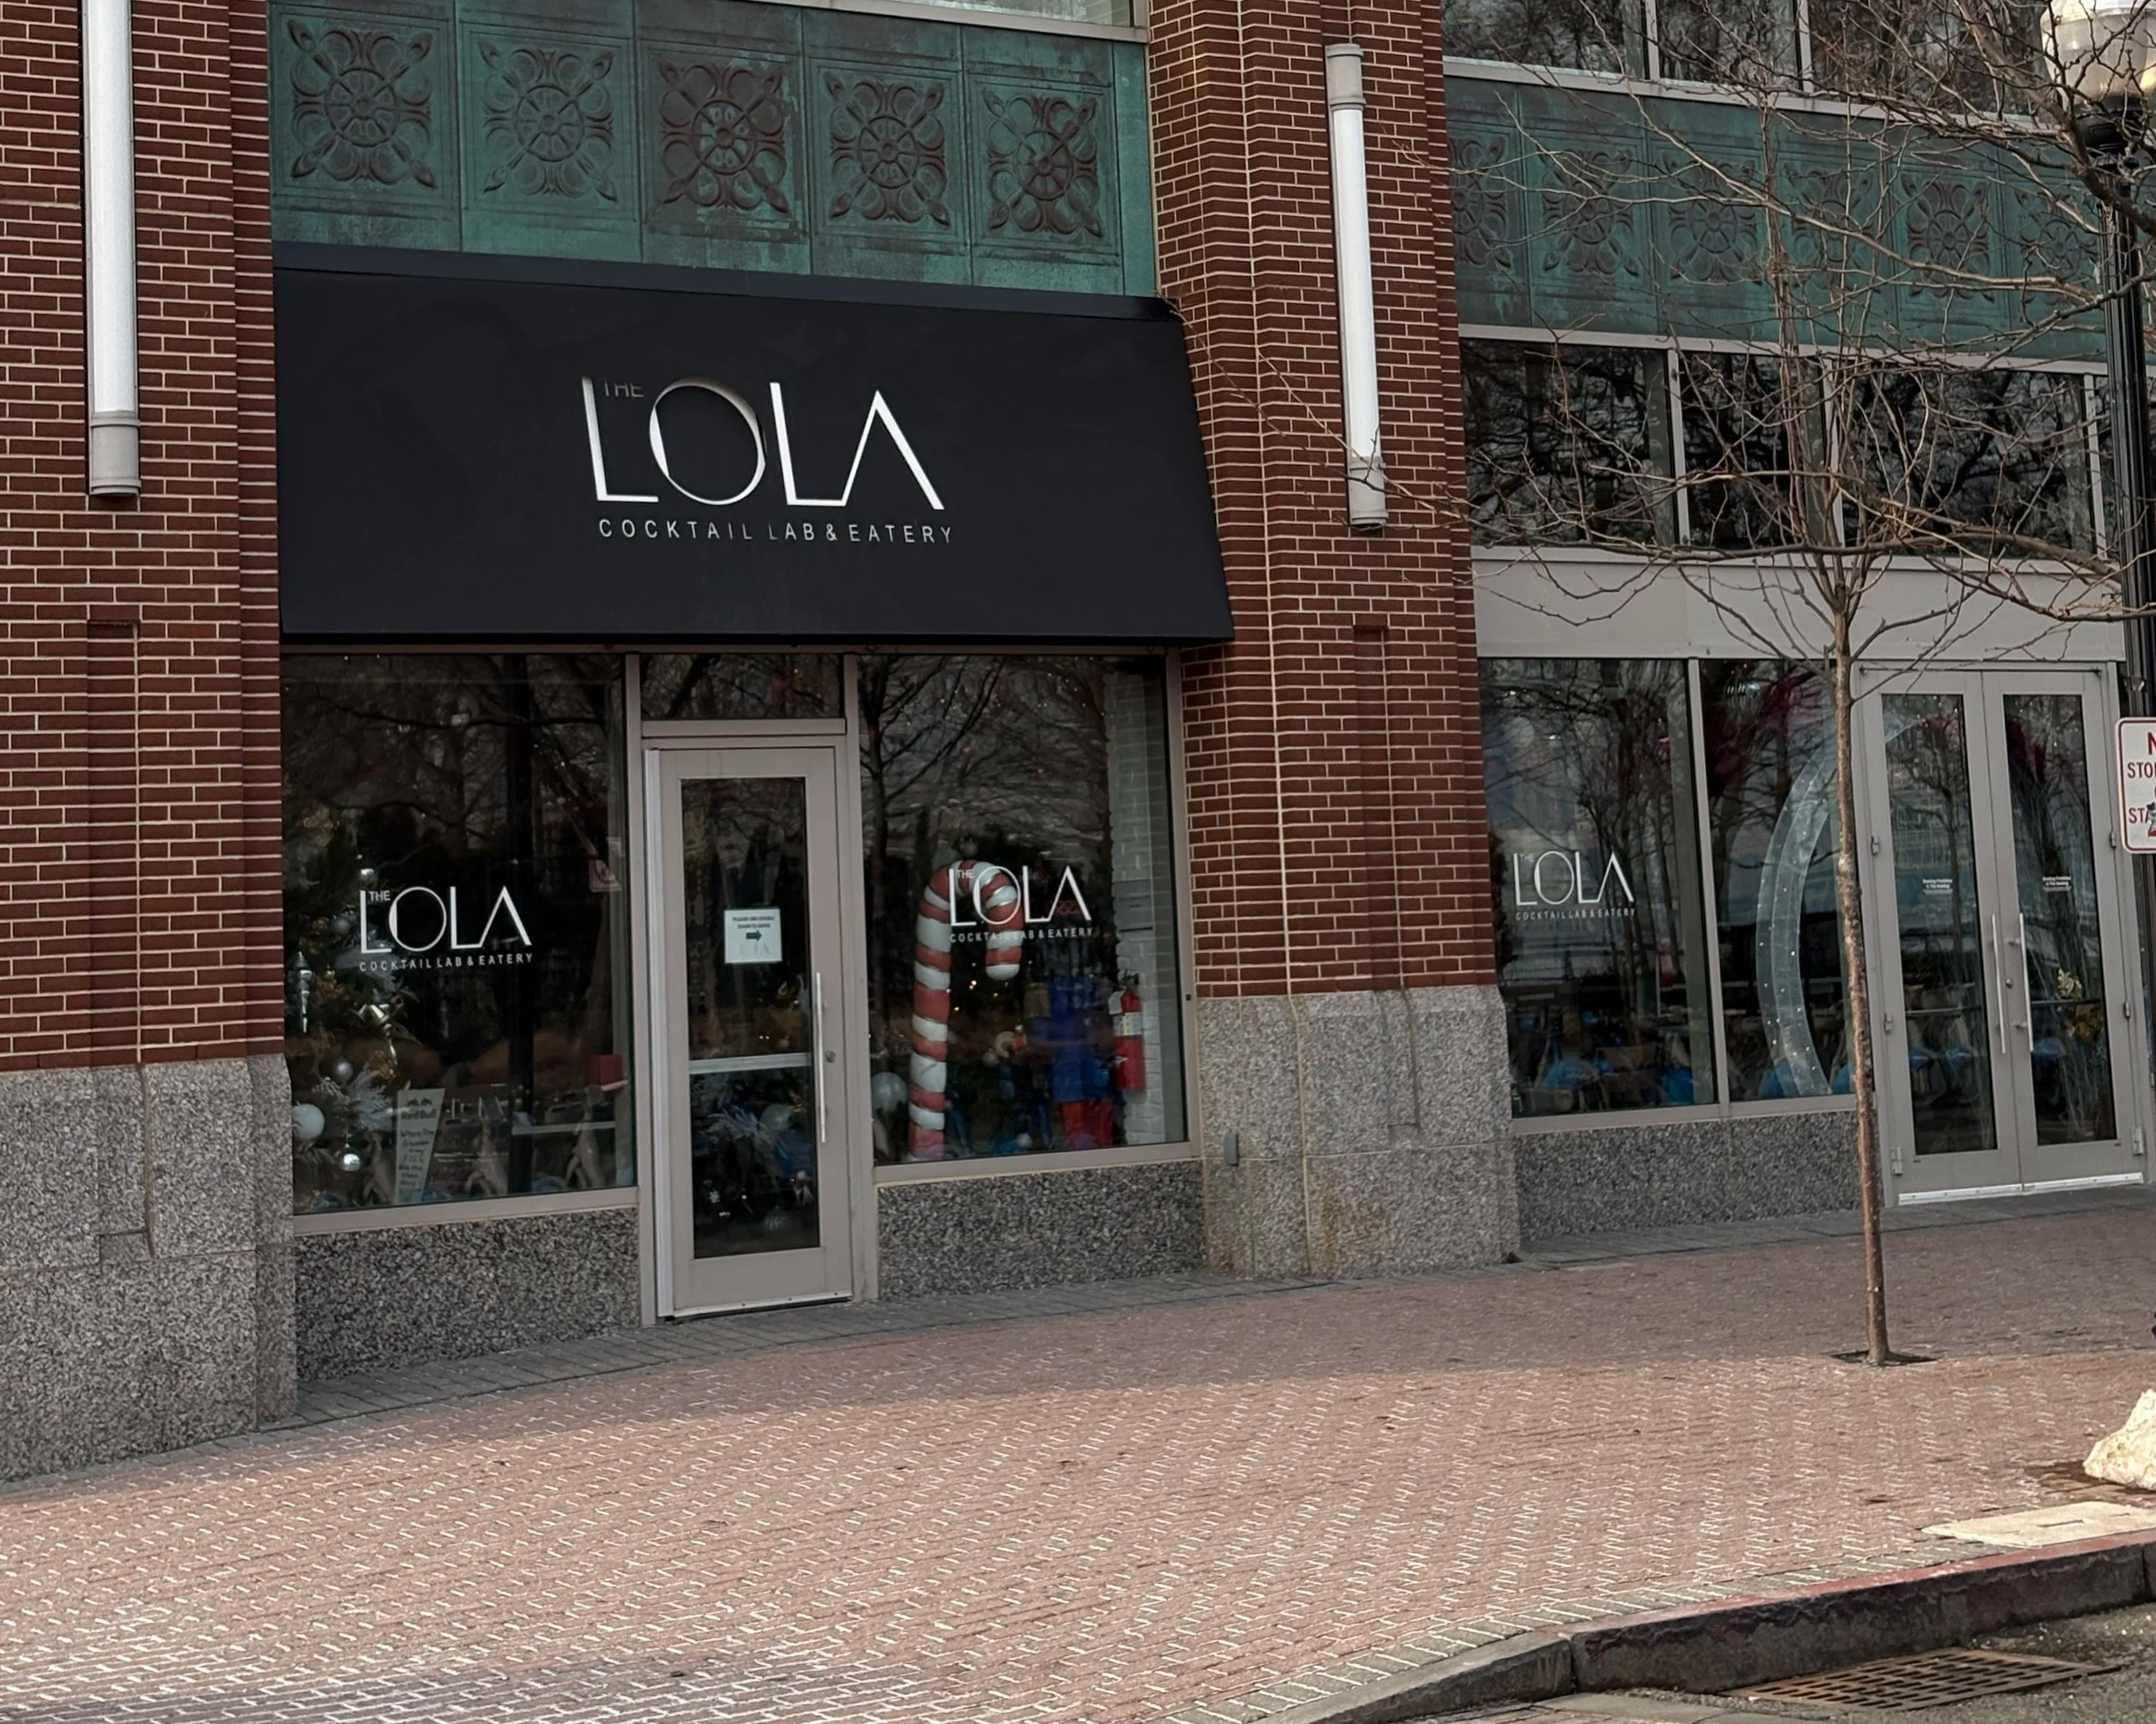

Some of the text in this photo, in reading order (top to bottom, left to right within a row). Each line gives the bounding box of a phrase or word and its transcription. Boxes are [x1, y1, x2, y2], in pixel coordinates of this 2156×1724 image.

[604, 380, 644, 397] THE
[582, 377, 944, 510] LOLA
[598, 519, 952, 543] COCKTAIL LAB & EATERY
[2127, 761, 2156, 779] STO
[956, 868, 974, 879] THE
[1513, 851, 1634, 906] LOLA
[369, 890, 391, 901] THE
[949, 865, 1092, 927] LOLA
[359, 885, 532, 954] LOLA
[1515, 911, 1566, 921] COCKTAIL
[1597, 907, 1635, 918] EATERY
[1048, 927, 1093, 939] EATERY
[359, 952, 533, 972] COCKTAIL LAB & EATERY
[401, 1108, 438, 1120] Red Bull
